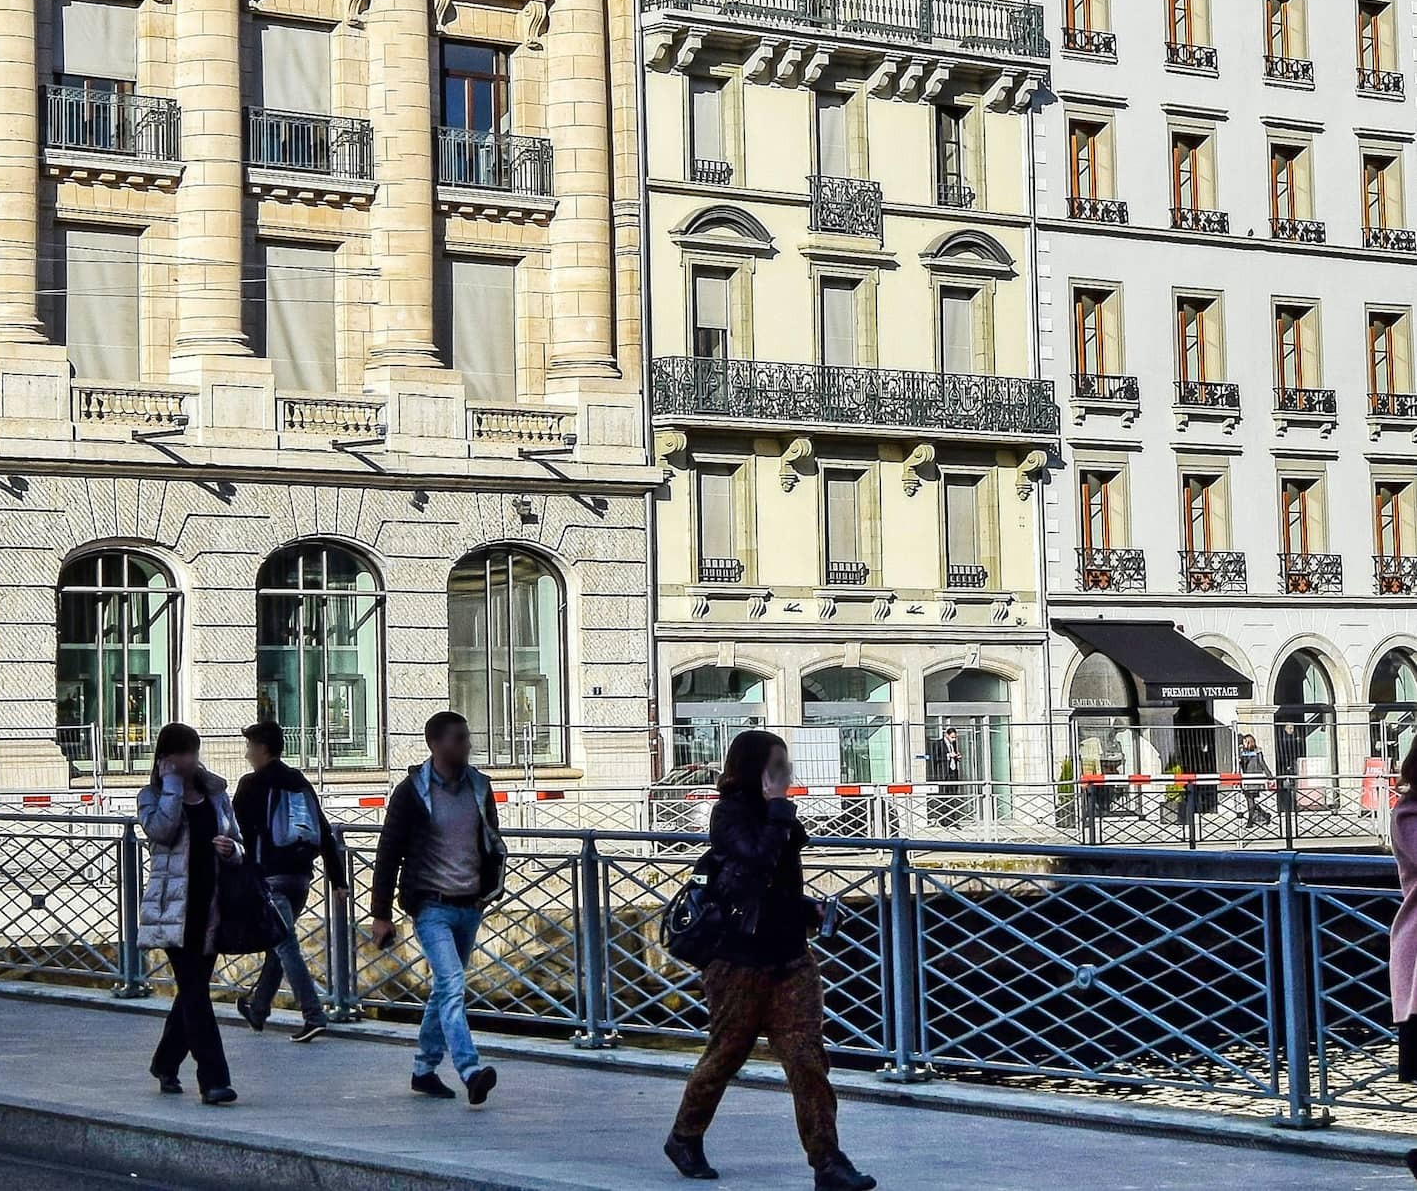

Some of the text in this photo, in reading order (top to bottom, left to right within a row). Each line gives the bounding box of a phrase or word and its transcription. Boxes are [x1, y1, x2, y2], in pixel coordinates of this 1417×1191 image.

[971, 652, 978, 665] 7
[1161, 686, 1239, 698] PREMIUM VINTAGE
